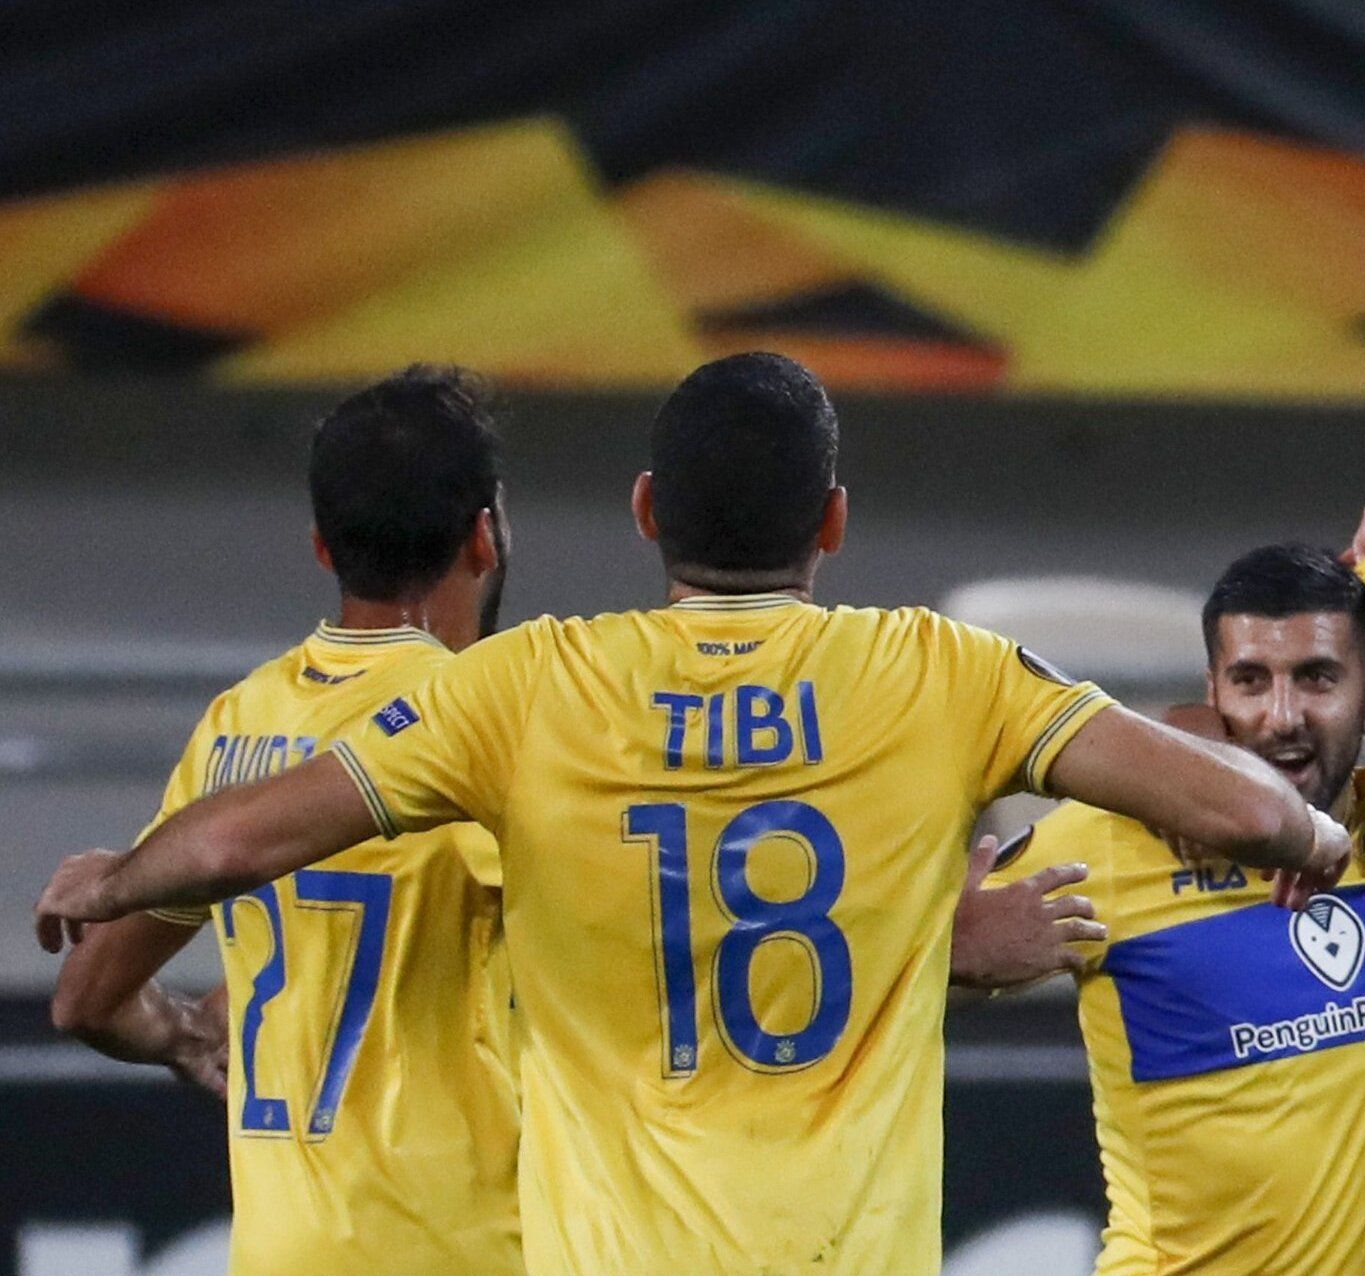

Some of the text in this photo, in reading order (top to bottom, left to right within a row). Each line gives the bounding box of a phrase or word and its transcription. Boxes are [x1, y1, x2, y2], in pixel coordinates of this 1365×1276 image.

[652, 680, 824, 770] TIBI
[623, 801, 853, 1079] 18
[1171, 864, 1248, 895] FILA
[222, 869, 393, 1141] 27
